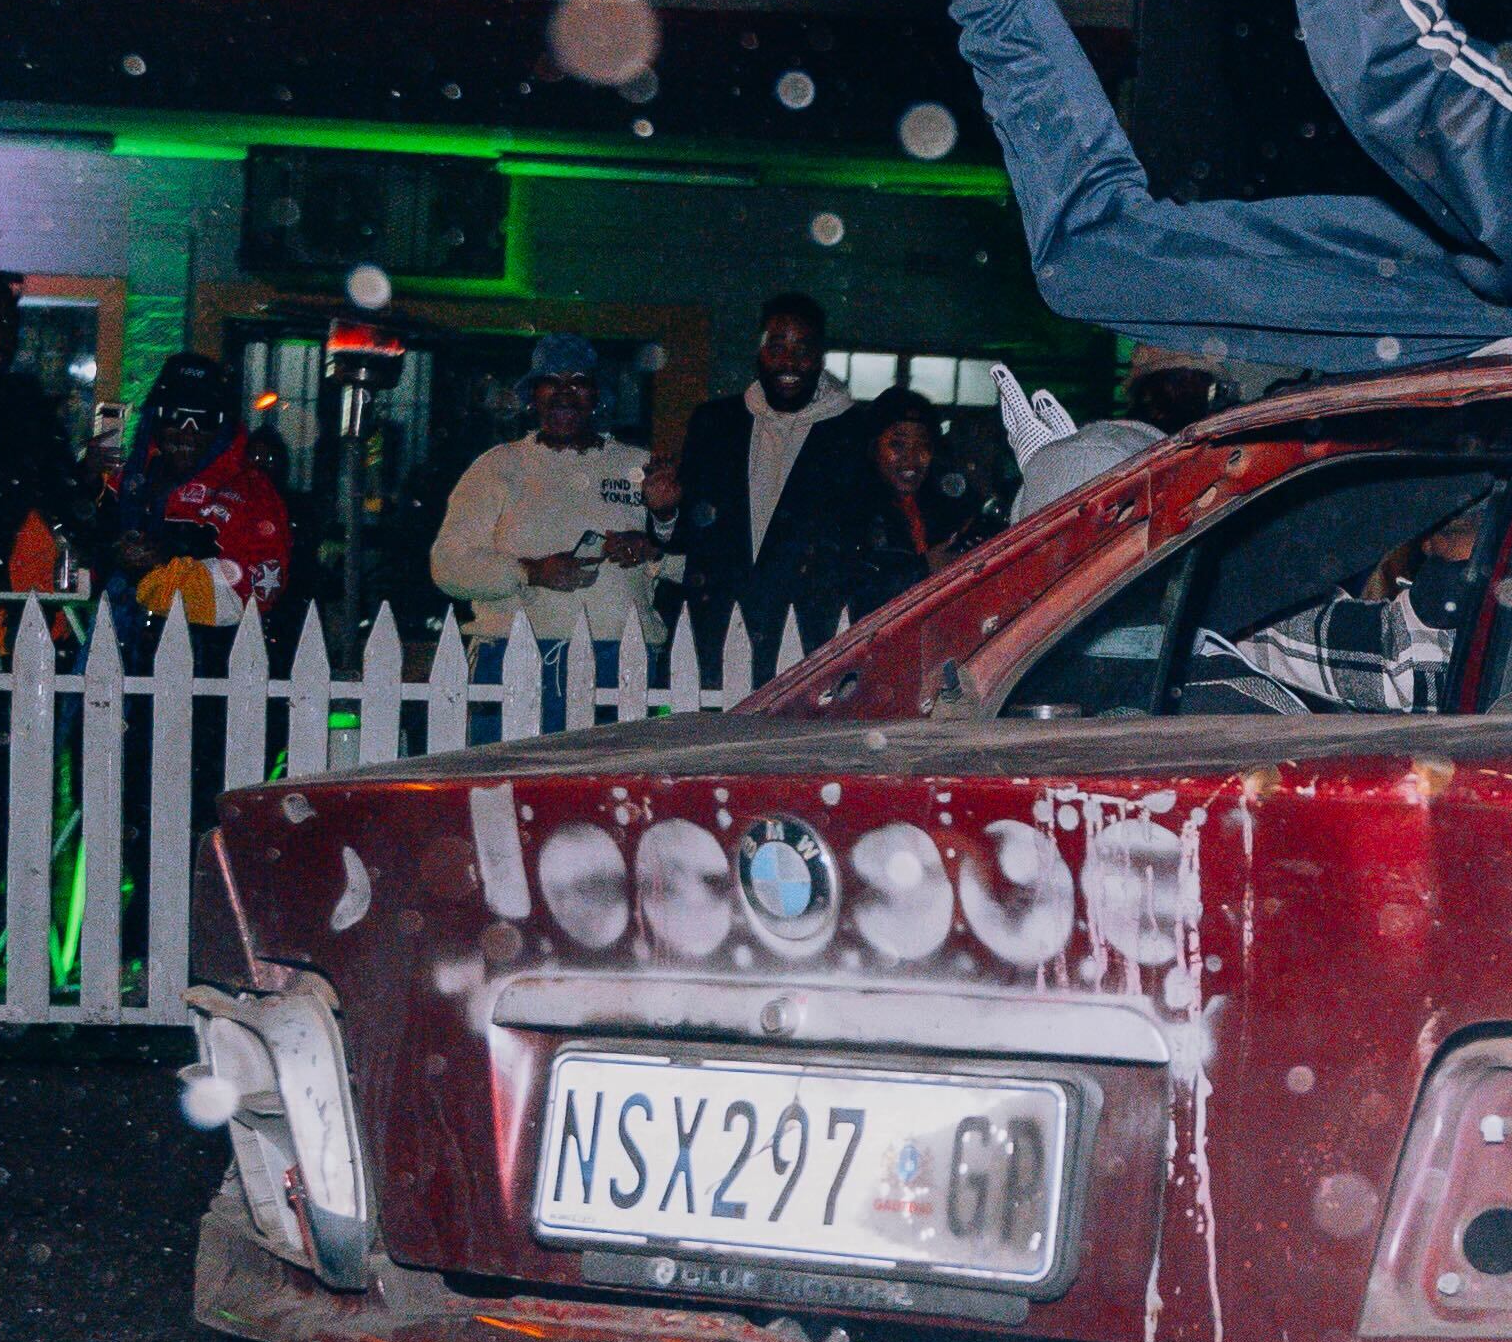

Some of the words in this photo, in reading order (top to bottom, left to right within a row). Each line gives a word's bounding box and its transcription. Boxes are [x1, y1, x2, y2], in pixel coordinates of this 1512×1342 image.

[601, 478, 631, 491] FIND
[600, 491, 644, 507] YOURS
[741, 820, 821, 860] BMW
[553, 1087, 867, 1226] NSX297
[946, 1115, 1046, 1244] GP
